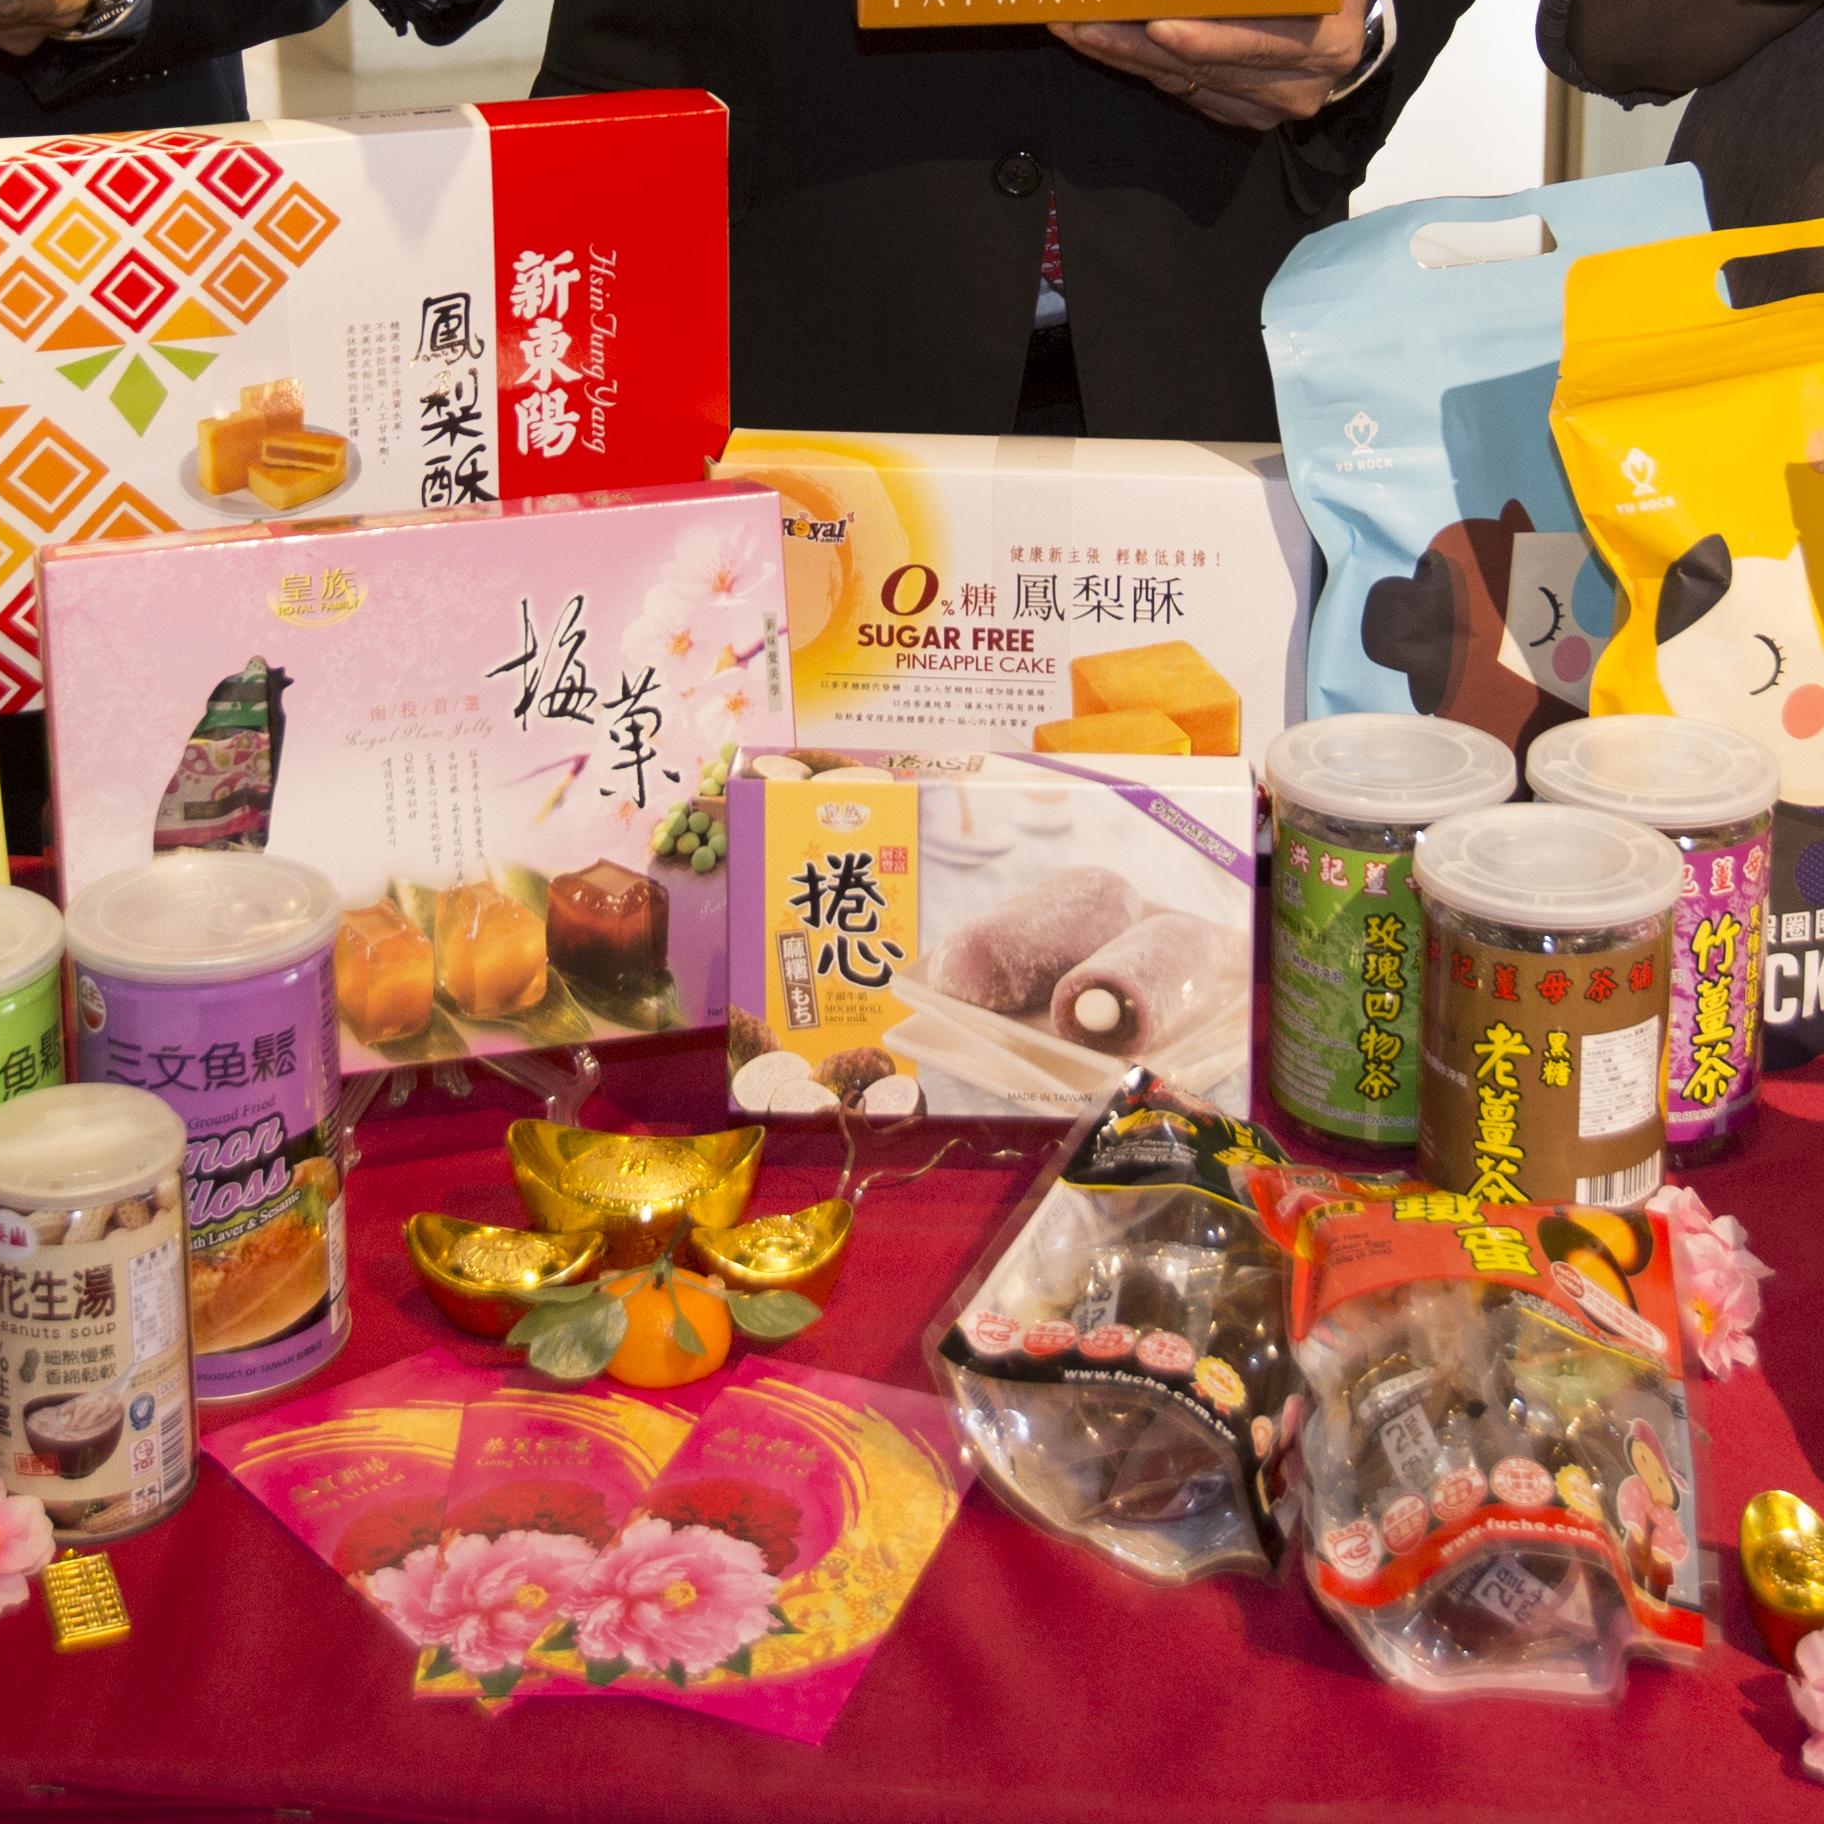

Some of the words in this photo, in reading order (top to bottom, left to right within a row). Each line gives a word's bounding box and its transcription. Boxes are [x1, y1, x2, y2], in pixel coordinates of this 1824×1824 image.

[587, 242, 618, 302] Hsin
[509, 249, 579, 456] 新東陽
[584, 303, 617, 375] Tung
[410, 291, 498, 507] 鳳梨酥
[582, 378, 610, 455] Yang
[1336, 461, 1352, 472] YU
[1358, 457, 1393, 470] ROCK
[1616, 503, 1634, 514] YU
[1640, 497, 1674, 512] ROCK
[1009, 546, 1100, 565] 健康新主張
[278, 602, 317, 617] ROYAL
[321, 598, 361, 614] FAMILY
[282, 568, 356, 603] 皇族
[1013, 572, 1184, 624] 鳳梨酥
[858, 625, 960, 650] SUGAR
[972, 627, 1035, 652] FREE
[896, 653, 992, 674] PINEAPPLE
[999, 655, 1055, 675] CAKE
[789, 853, 905, 987] 捲心
[825, 1005, 857, 1013] MOCHI
[847, 1014, 867, 1023] milk
[1357, 914, 1406, 1101] 玫瑰四物茶
[1683, 912, 1741, 1106] 竹薑茶
[106, 1027, 296, 1091] 三文魚鬆
[1541, 1029, 1572, 1087] 黑糖
[188, 1109, 239, 1129] Ground
[242, 1095, 276, 1118] Fried
[1008, 1092, 1038, 1102] MADE
[1042, 1092, 1050, 1102] IN
[1053, 1093, 1092, 1103] TAIWAN
[1474, 1022, 1531, 1203] 老薑茶
[208, 1225, 246, 1246] Laver
[247, 1219, 256, 1230] &
[259, 1190, 301, 1222] Sesame
[72, 1322, 116, 1341] soup
[259, 1356, 294, 1372] TAIWAN
[1064, 1368, 1236, 1441] www.fuche.com.tw
